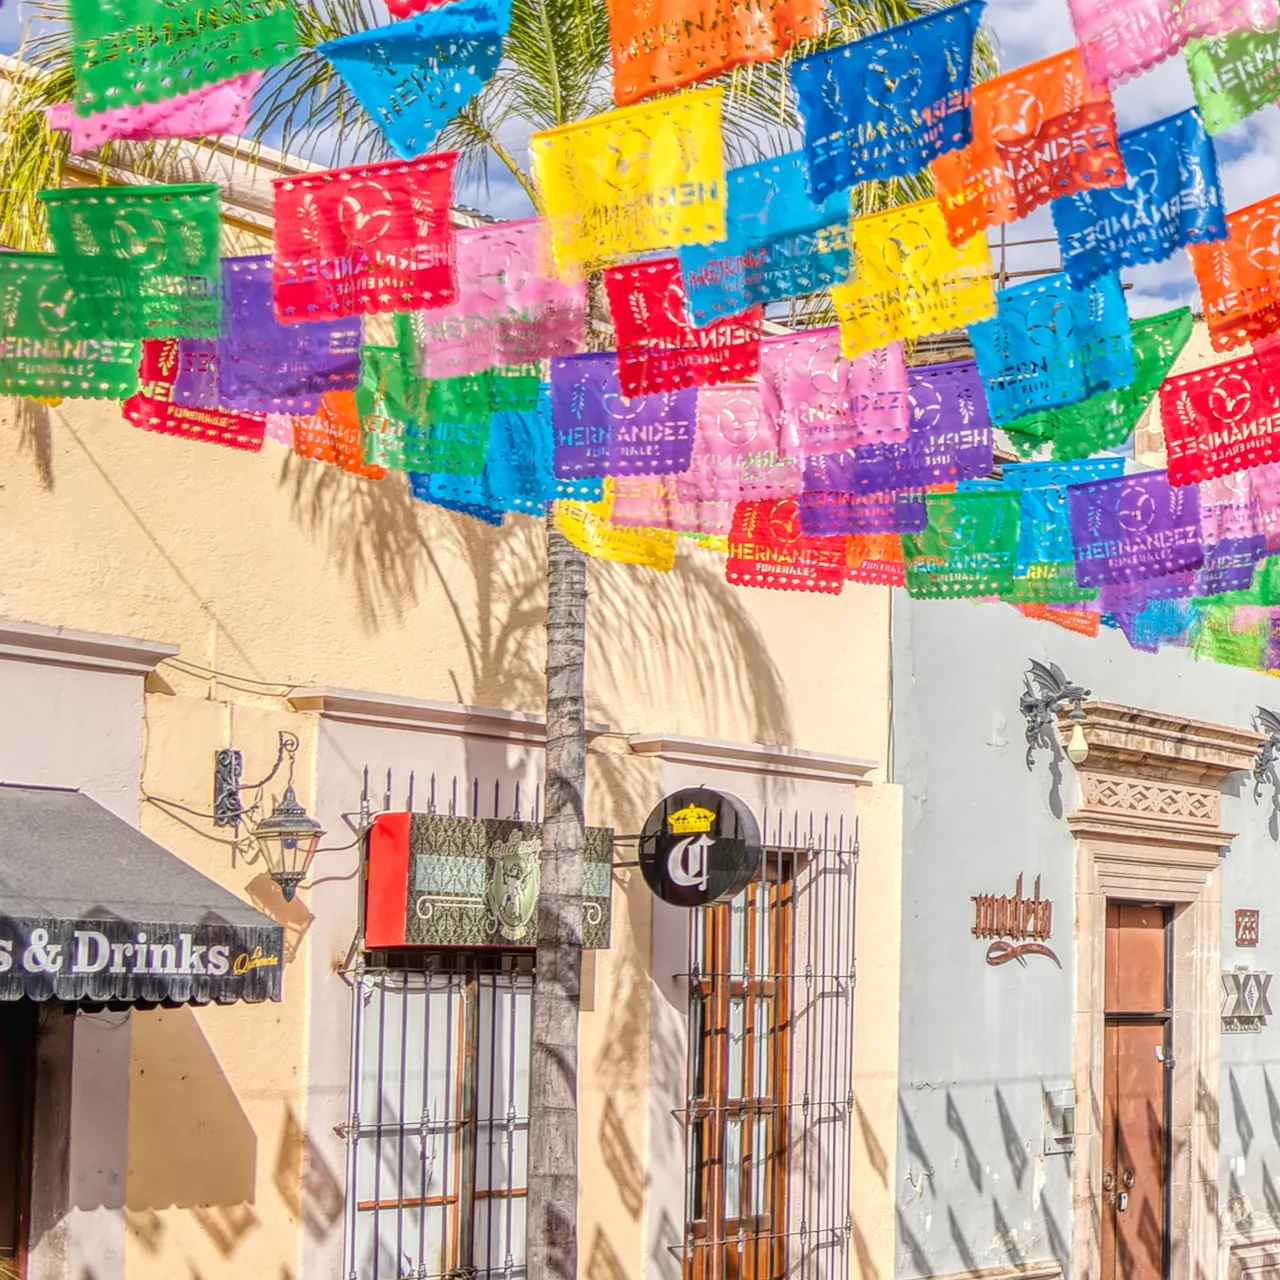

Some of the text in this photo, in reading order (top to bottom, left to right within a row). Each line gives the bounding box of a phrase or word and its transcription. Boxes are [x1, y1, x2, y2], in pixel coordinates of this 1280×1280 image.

[0, 336, 137, 364] ERNANDEZ
[558, 421, 690, 448] HERNANDEZ
[731, 542, 841, 568] HERNANDEZ
[1078, 524, 1198, 562] HERNANDEZ
[756, 561, 818, 578] FUNERALES
[1108, 549, 1174, 569] FUNERALES
[23, 928, 63, 973] &
[72, 930, 230, 976] Drinks
